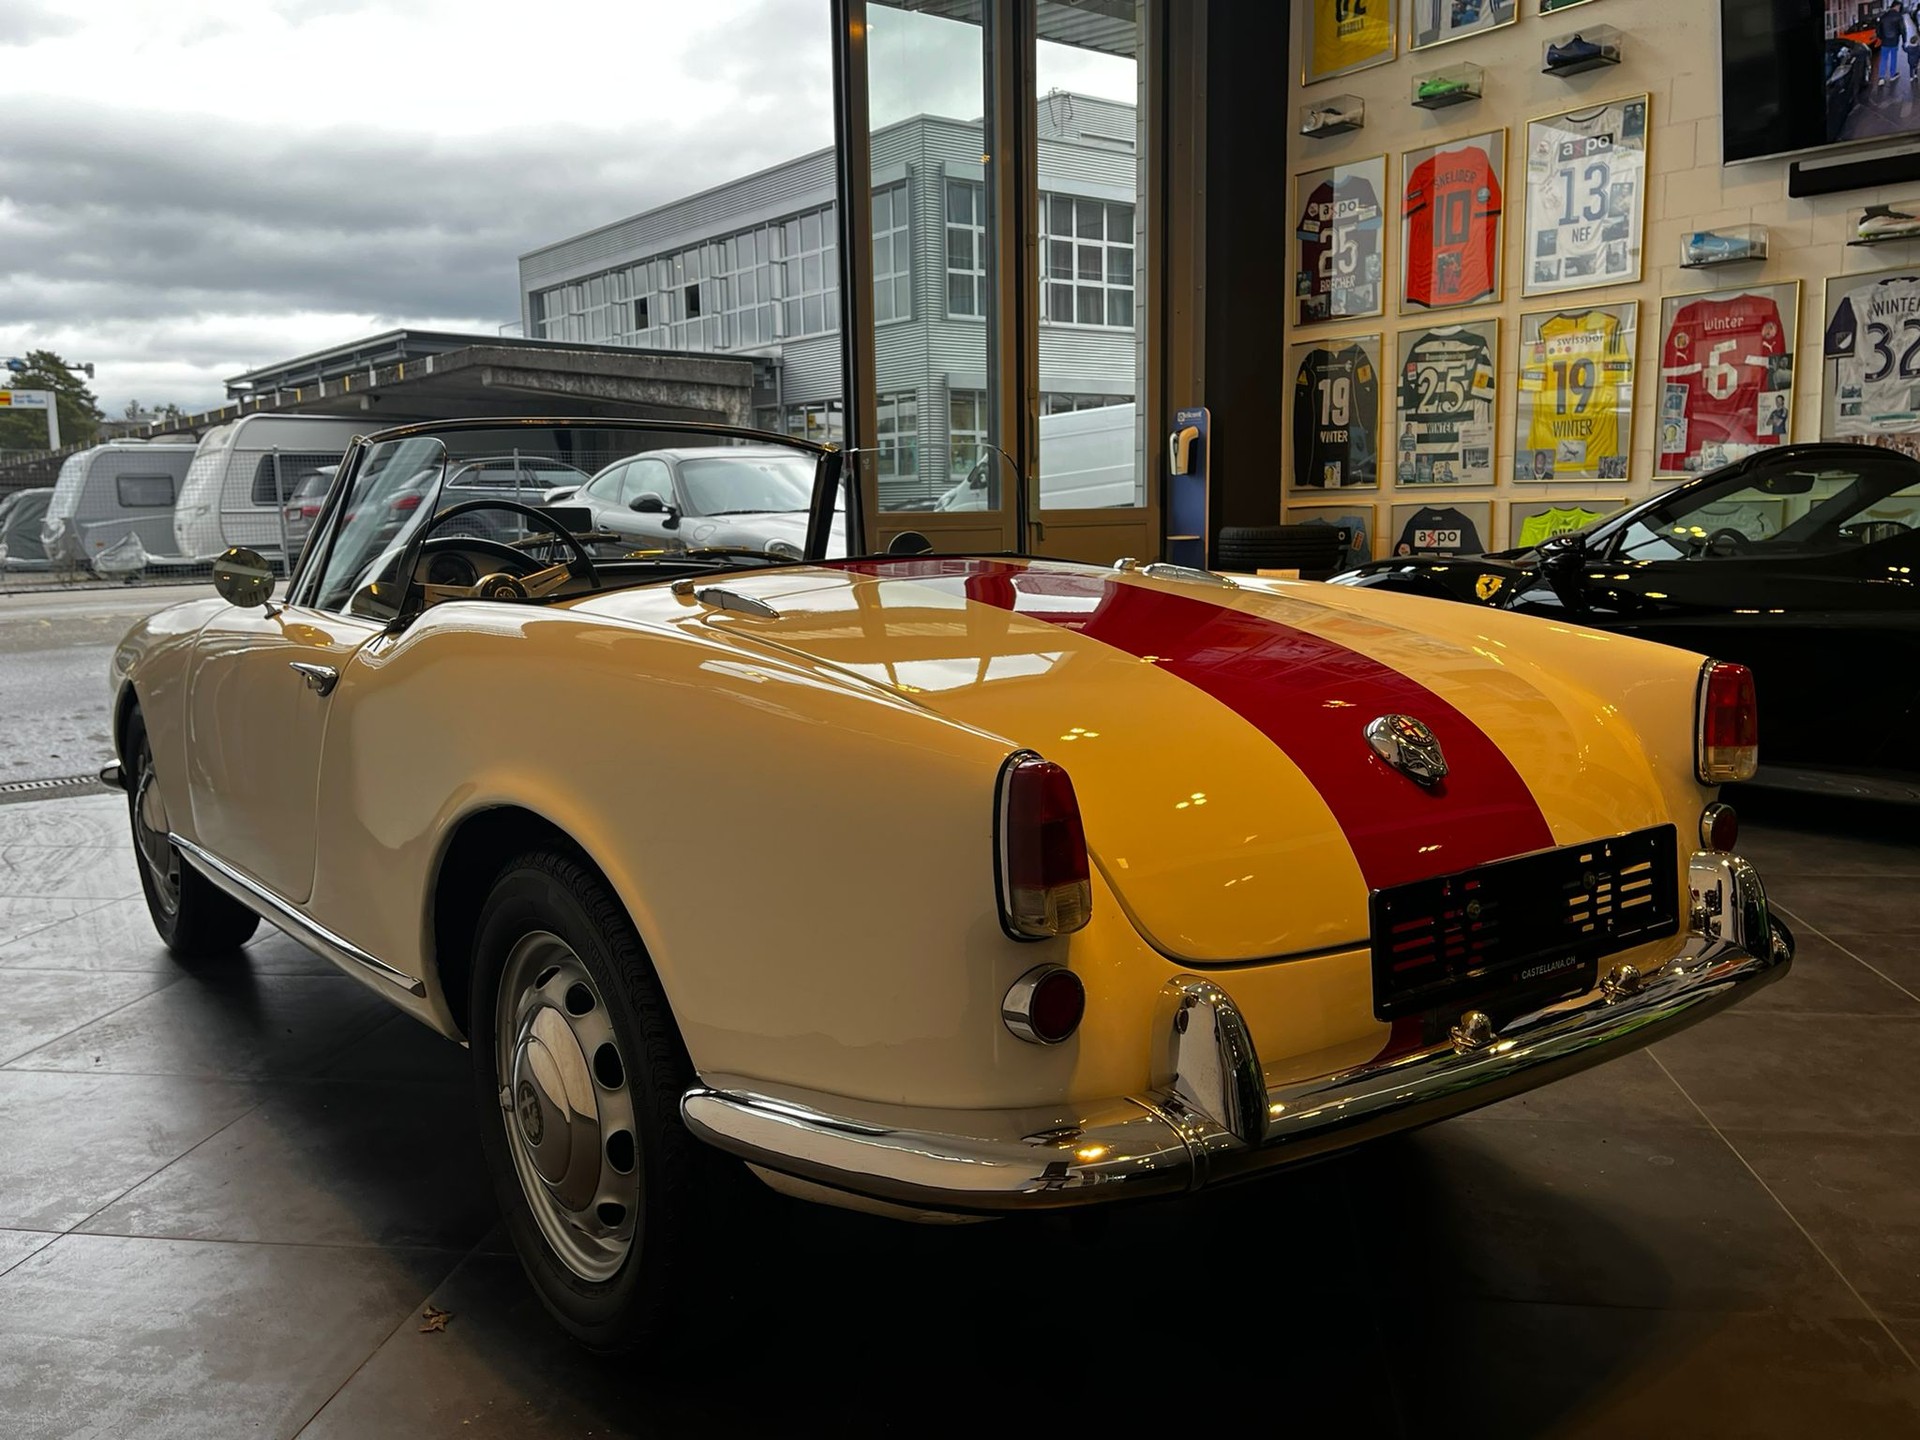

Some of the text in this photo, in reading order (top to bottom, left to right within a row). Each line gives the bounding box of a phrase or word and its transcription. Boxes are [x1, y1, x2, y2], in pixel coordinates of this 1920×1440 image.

[1434, 189, 1472, 248] 10
[1558, 161, 1610, 226] 13
[1318, 222, 1359, 278] 25
[1571, 226, 1592, 243] NEF
[1703, 339, 1738, 400] 6
[1864, 318, 1920, 382] 32
[1318, 376, 1350, 427] 19
[1416, 366, 1465, 414] 25
[1552, 358, 1596, 416] 19
[1425, 421, 1455, 434] WINTER
[1552, 419, 1593, 438] WINTER
[1521, 955, 1576, 980] CASTELLANA.CH
